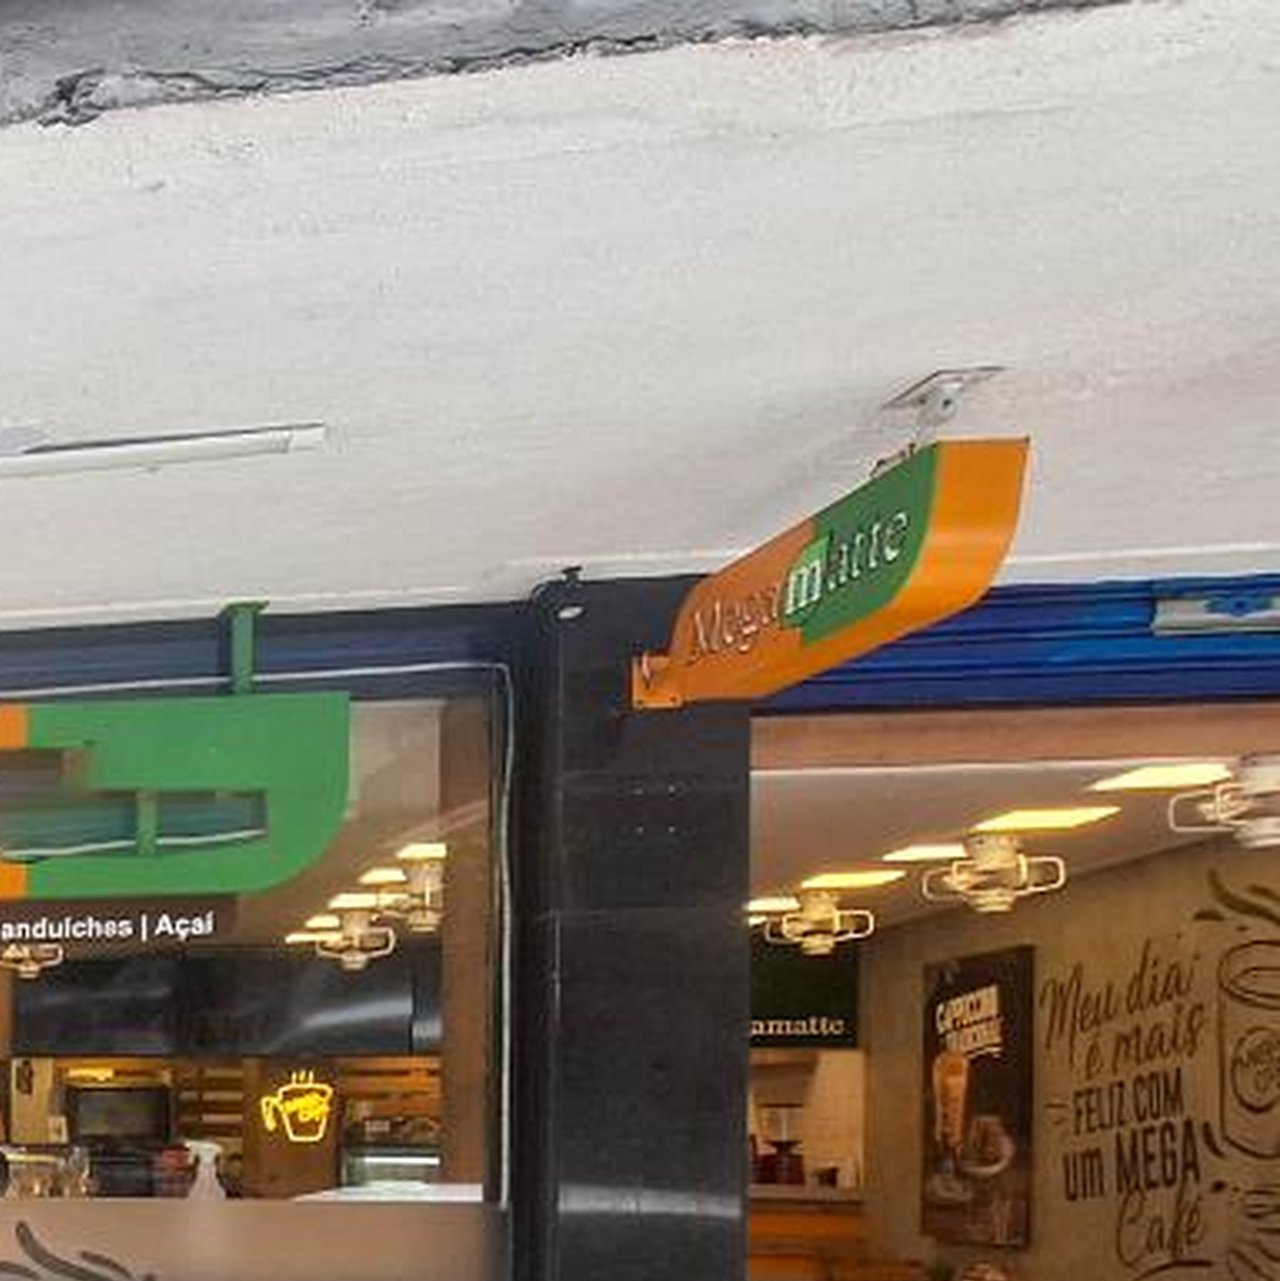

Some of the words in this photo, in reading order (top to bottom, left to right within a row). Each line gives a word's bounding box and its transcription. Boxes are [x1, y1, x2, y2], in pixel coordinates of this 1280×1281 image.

[154, 911, 214, 943] Açaí
[1040, 962, 1118, 1068] Meu
[1126, 939, 1194, 1014] dia
[1113, 1003, 1204, 1076] mais
[1073, 1080, 1126, 1136] FELIZ
[1133, 1066, 1185, 1124] COM
[1116, 1119, 1201, 1195] MEGA
[1116, 1182, 1205, 1268] Café
